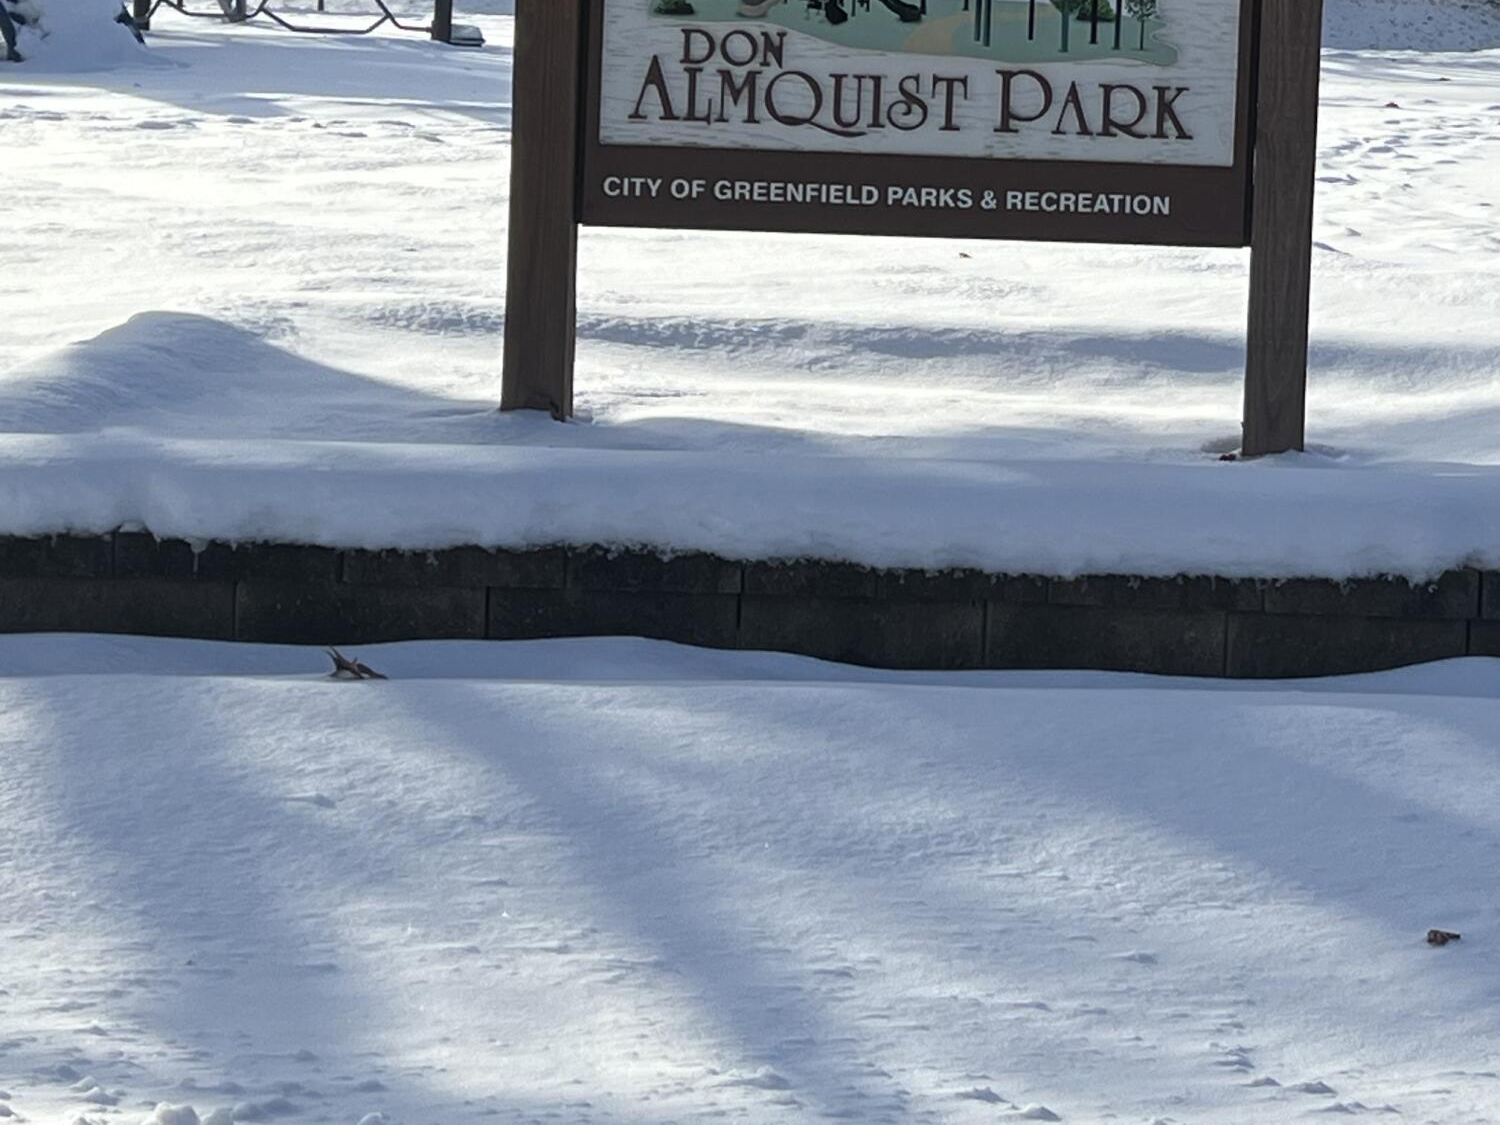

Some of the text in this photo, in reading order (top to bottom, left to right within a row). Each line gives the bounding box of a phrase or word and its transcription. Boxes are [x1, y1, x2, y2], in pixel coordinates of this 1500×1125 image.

[679, 28, 787, 69] DON
[628, 55, 1193, 140] ALMQUIST PARK
[603, 177, 1170, 215] CITY OF GREENFIELD PARKS & RECREATION
